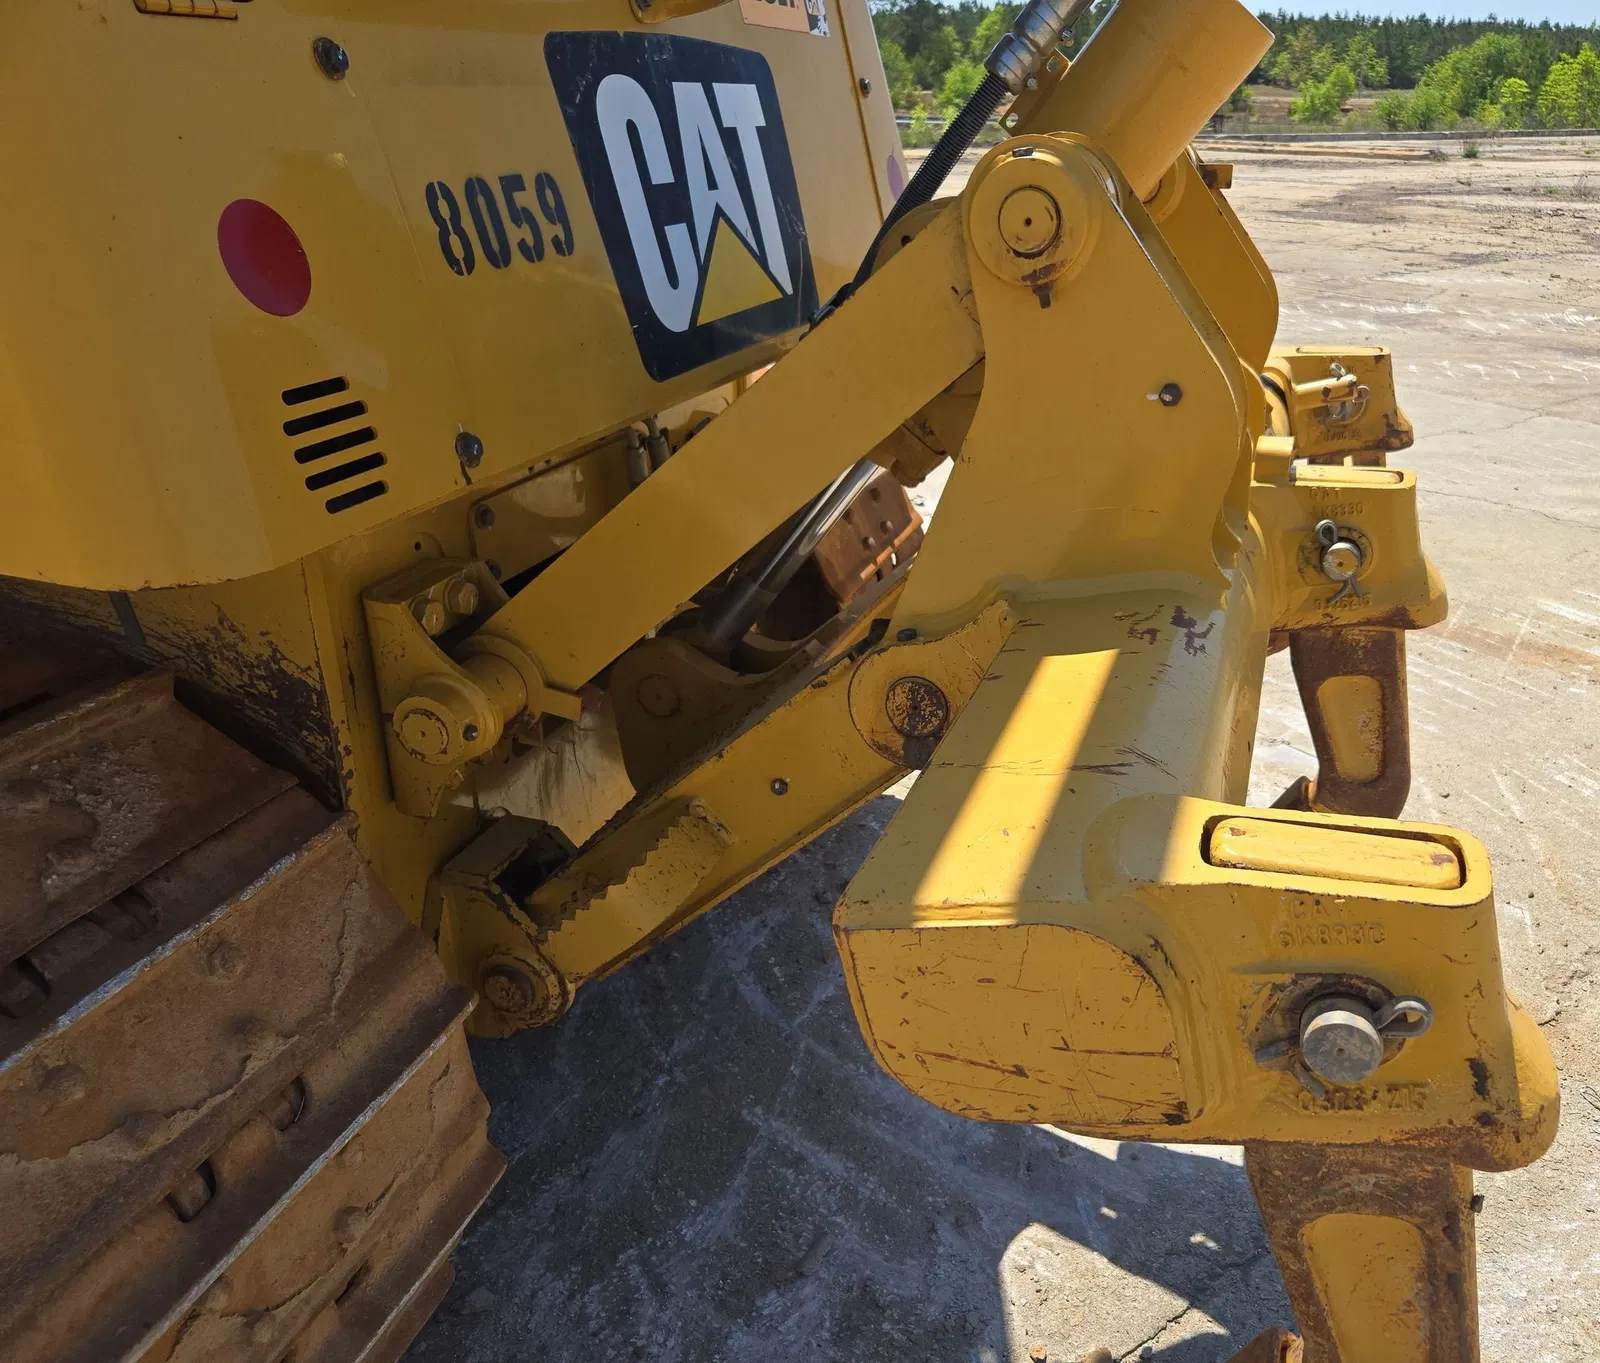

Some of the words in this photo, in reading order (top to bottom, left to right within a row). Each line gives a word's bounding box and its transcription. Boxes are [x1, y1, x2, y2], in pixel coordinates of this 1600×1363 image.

[425, 171, 575, 277] 8059
[595, 73, 793, 332] CAT
[1289, 898, 1347, 920] CAT
